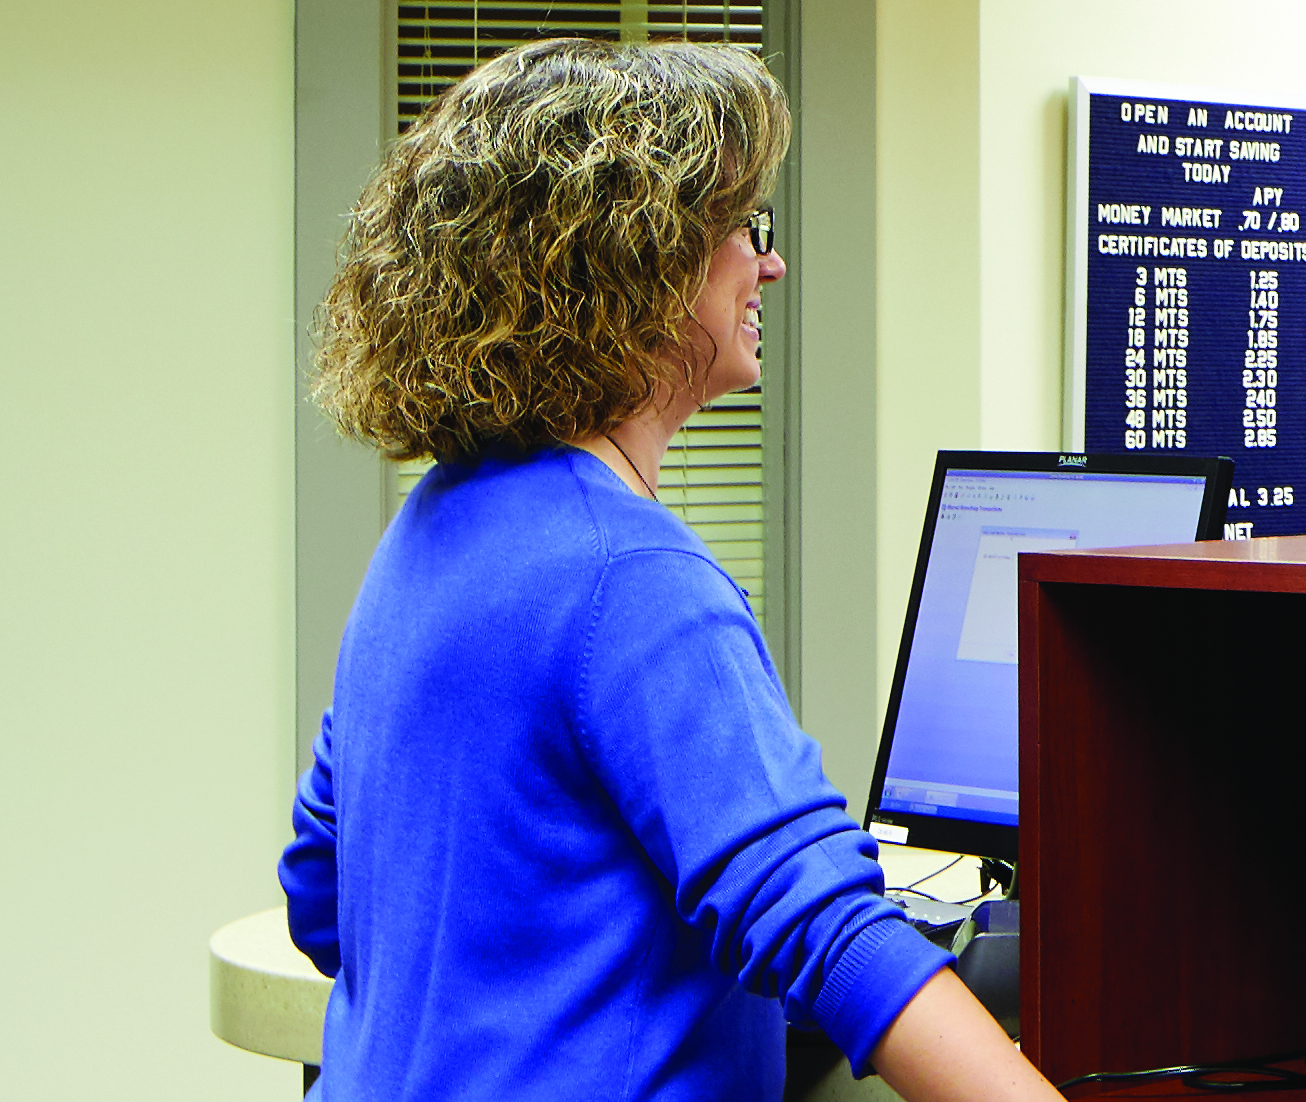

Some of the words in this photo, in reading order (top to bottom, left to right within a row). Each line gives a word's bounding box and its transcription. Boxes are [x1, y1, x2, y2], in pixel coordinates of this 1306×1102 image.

[1120, 101, 1169, 125] OPEN
[1187, 107, 1208, 128] AN
[1225, 110, 1293, 134] ACCOUNT
[1137, 133, 1170, 155] AND
[1174, 136, 1224, 160] START
[1228, 139, 1281, 163] SAVING
[1181, 161, 1231, 184] TODAY
[1252, 186, 1284, 207] APY
[1097, 203, 1152, 226] MONEY
[1161, 206, 1223, 229] MARKET
[1098, 234, 1208, 259] CERTIFICATES
[1213, 238, 1235, 259] OF
[1135, 266, 1148, 286] 3
[1154, 267, 1187, 288] MTS
[1134, 287, 1146, 307] 6
[1155, 287, 1189, 308] MTS
[1128, 307, 1146, 327] 12
[1154, 307, 1189, 328] MTS
[1127, 327, 1145, 348] 18
[1154, 327, 1189, 349] MTS
[1125, 347, 1146, 368] 24
[1153, 347, 1187, 369] MTS
[1124, 368, 1147, 388] 30
[1152, 368, 1187, 389] MTS
[1125, 388, 1147, 409] 36
[1153, 388, 1188, 409] MTS
[1125, 409, 1146, 429] 48
[1151, 409, 1187, 429] MTS
[1124, 429, 1147, 449] 60
[1152, 429, 1187, 449] MTS
[1058, 455, 1088, 465] PLANAR
[1257, 486, 1294, 507] 3.25
[1223, 522, 1254, 541] NET
